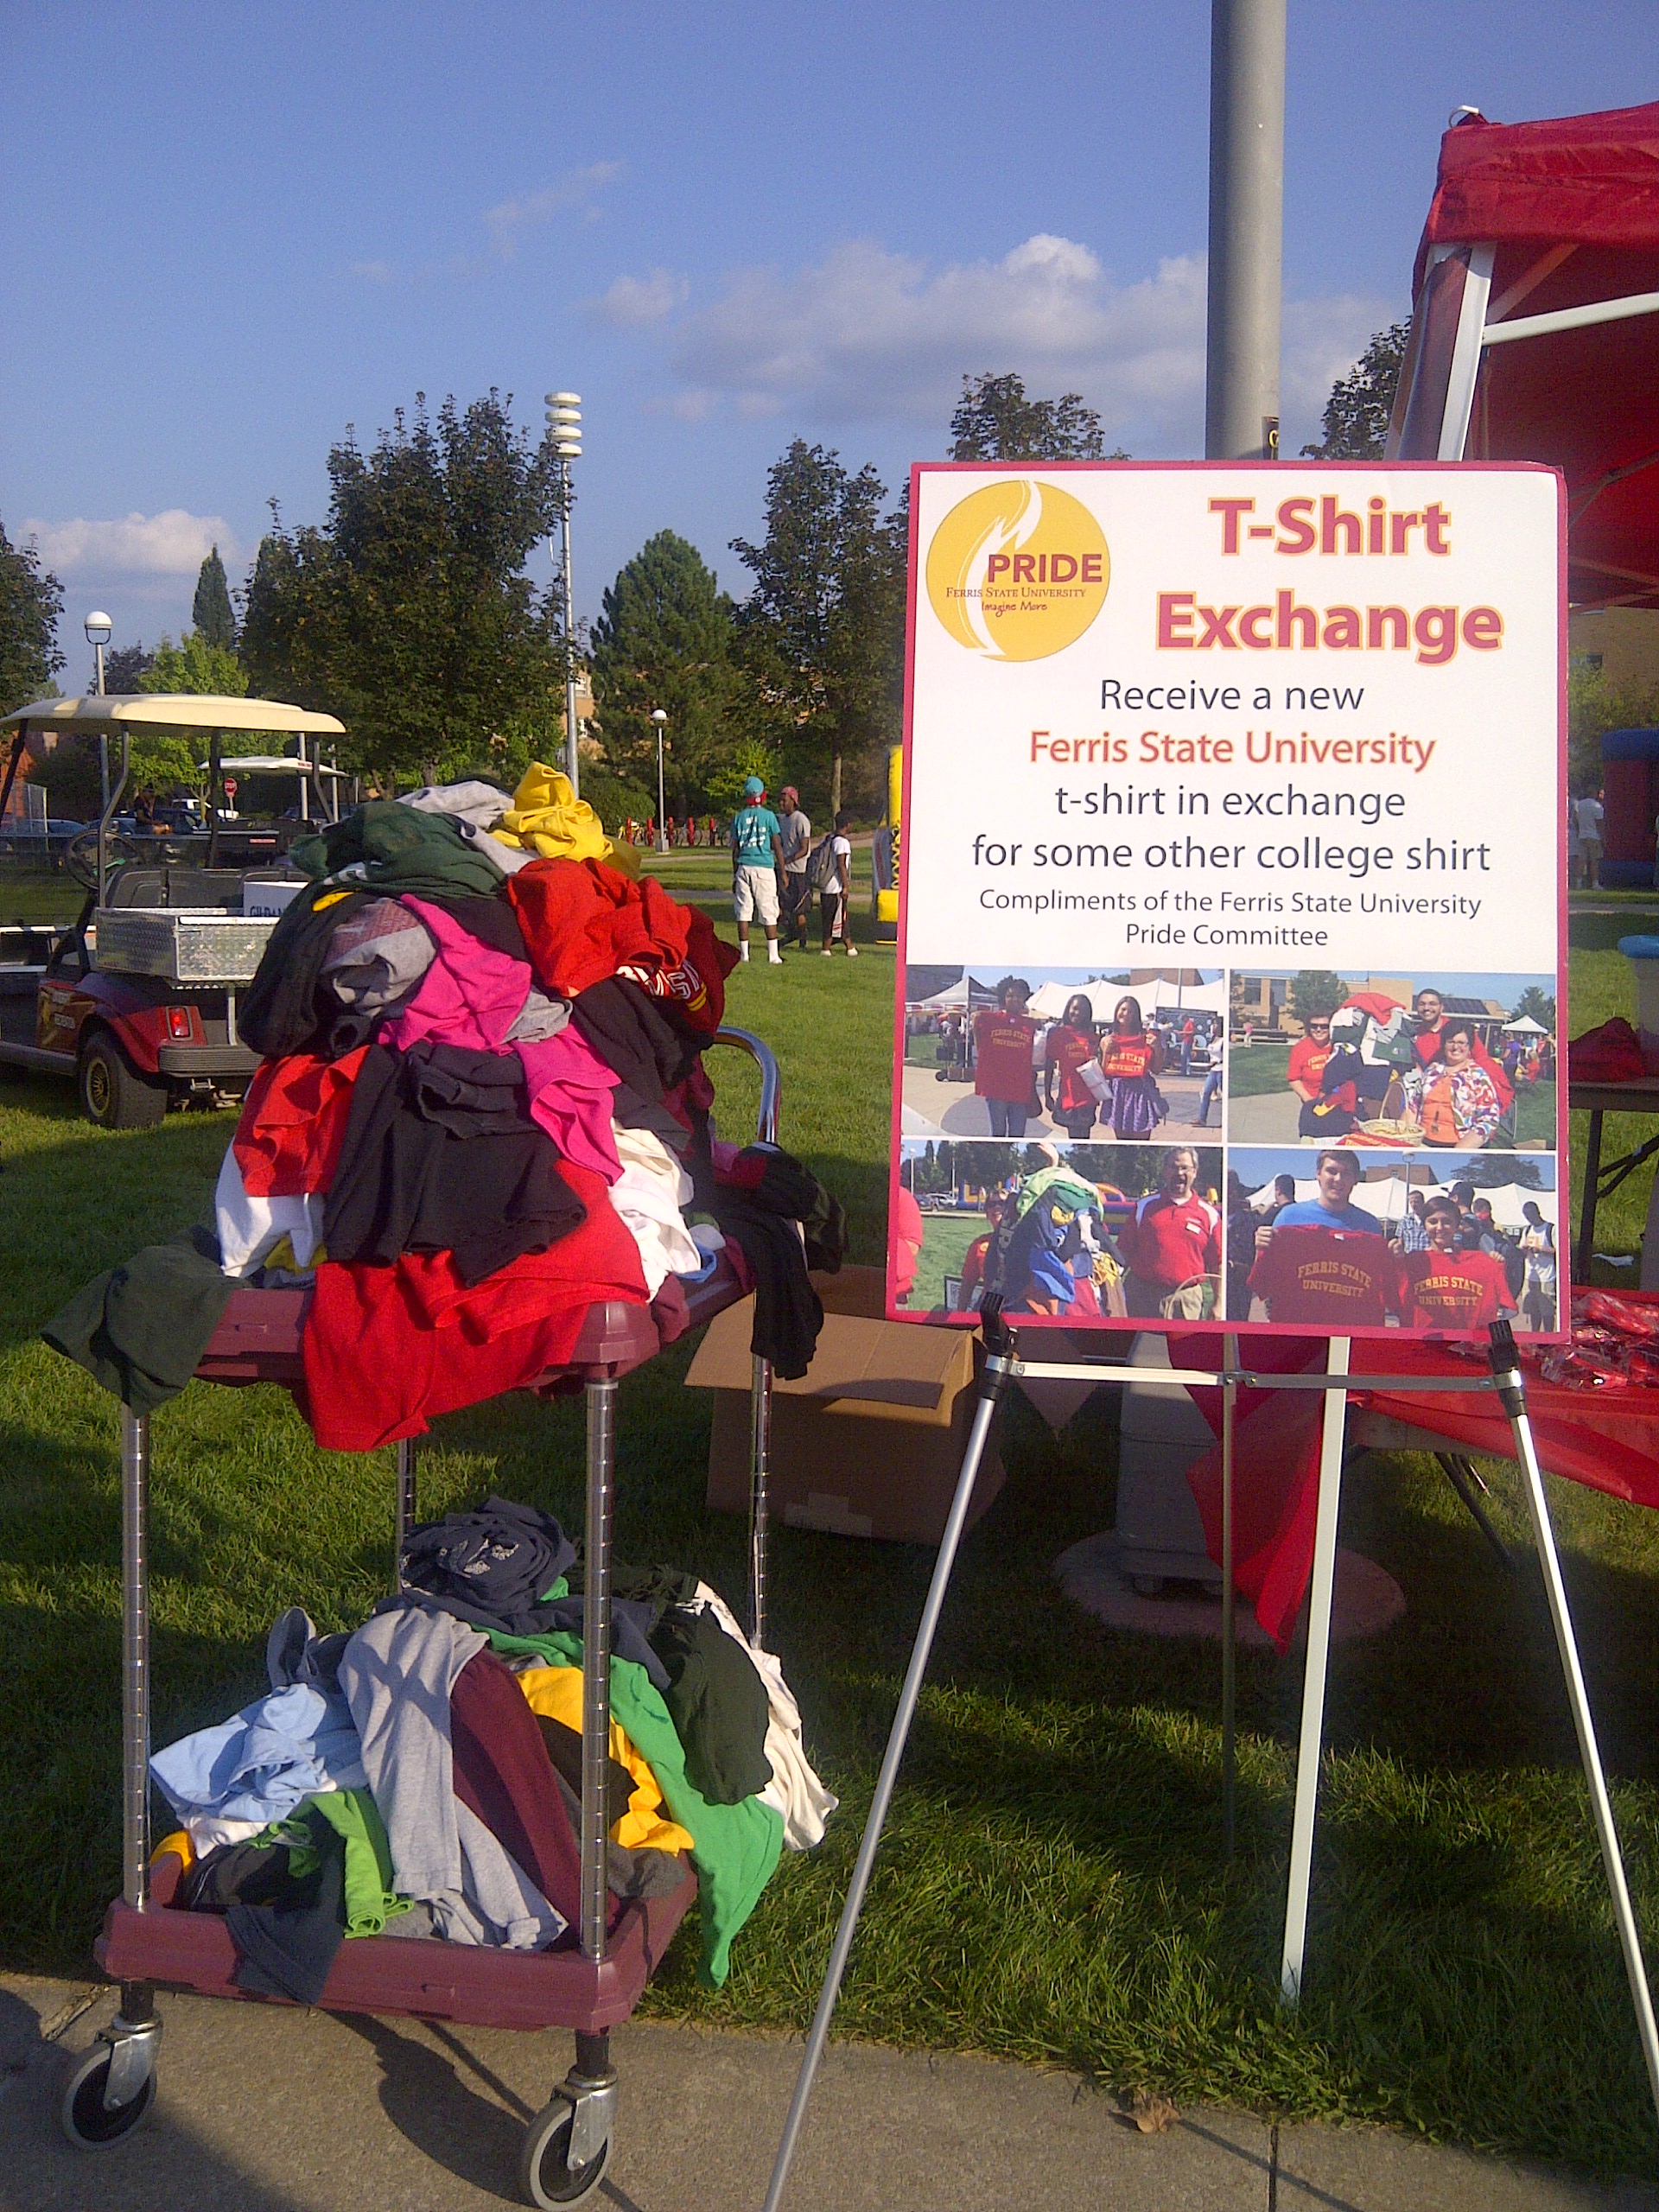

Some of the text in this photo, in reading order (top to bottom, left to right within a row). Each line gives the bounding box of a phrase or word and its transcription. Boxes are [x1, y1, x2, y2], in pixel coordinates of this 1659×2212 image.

[1208, 494, 1451, 556] T-Shirt
[988, 553, 1103, 583] PRIDE
[946, 587, 1086, 598] FERRIS STATE UNIVERSITY
[982, 601, 1047, 617] Imagine More
[1156, 588, 1504, 666] Exchange
[1102, 679, 1364, 710] Receive a new
[1031, 731, 1436, 773] Ferris State University
[1055, 783, 1405, 824] t-shirt in exchange
[972, 834, 1491, 878] for some other college shirt
[980, 889, 1481, 919] Compliments of the Ferris State University
[1127, 924, 1328, 945] Pride Committee
[1298, 1261, 1372, 1288] FERRIS STATE
[1302, 1280, 1363, 1298] UNIVERSITY
[1414, 1276, 1483, 1296] FERRIS STATE
[1419, 1295, 1478, 1306] UNIVERSITY
